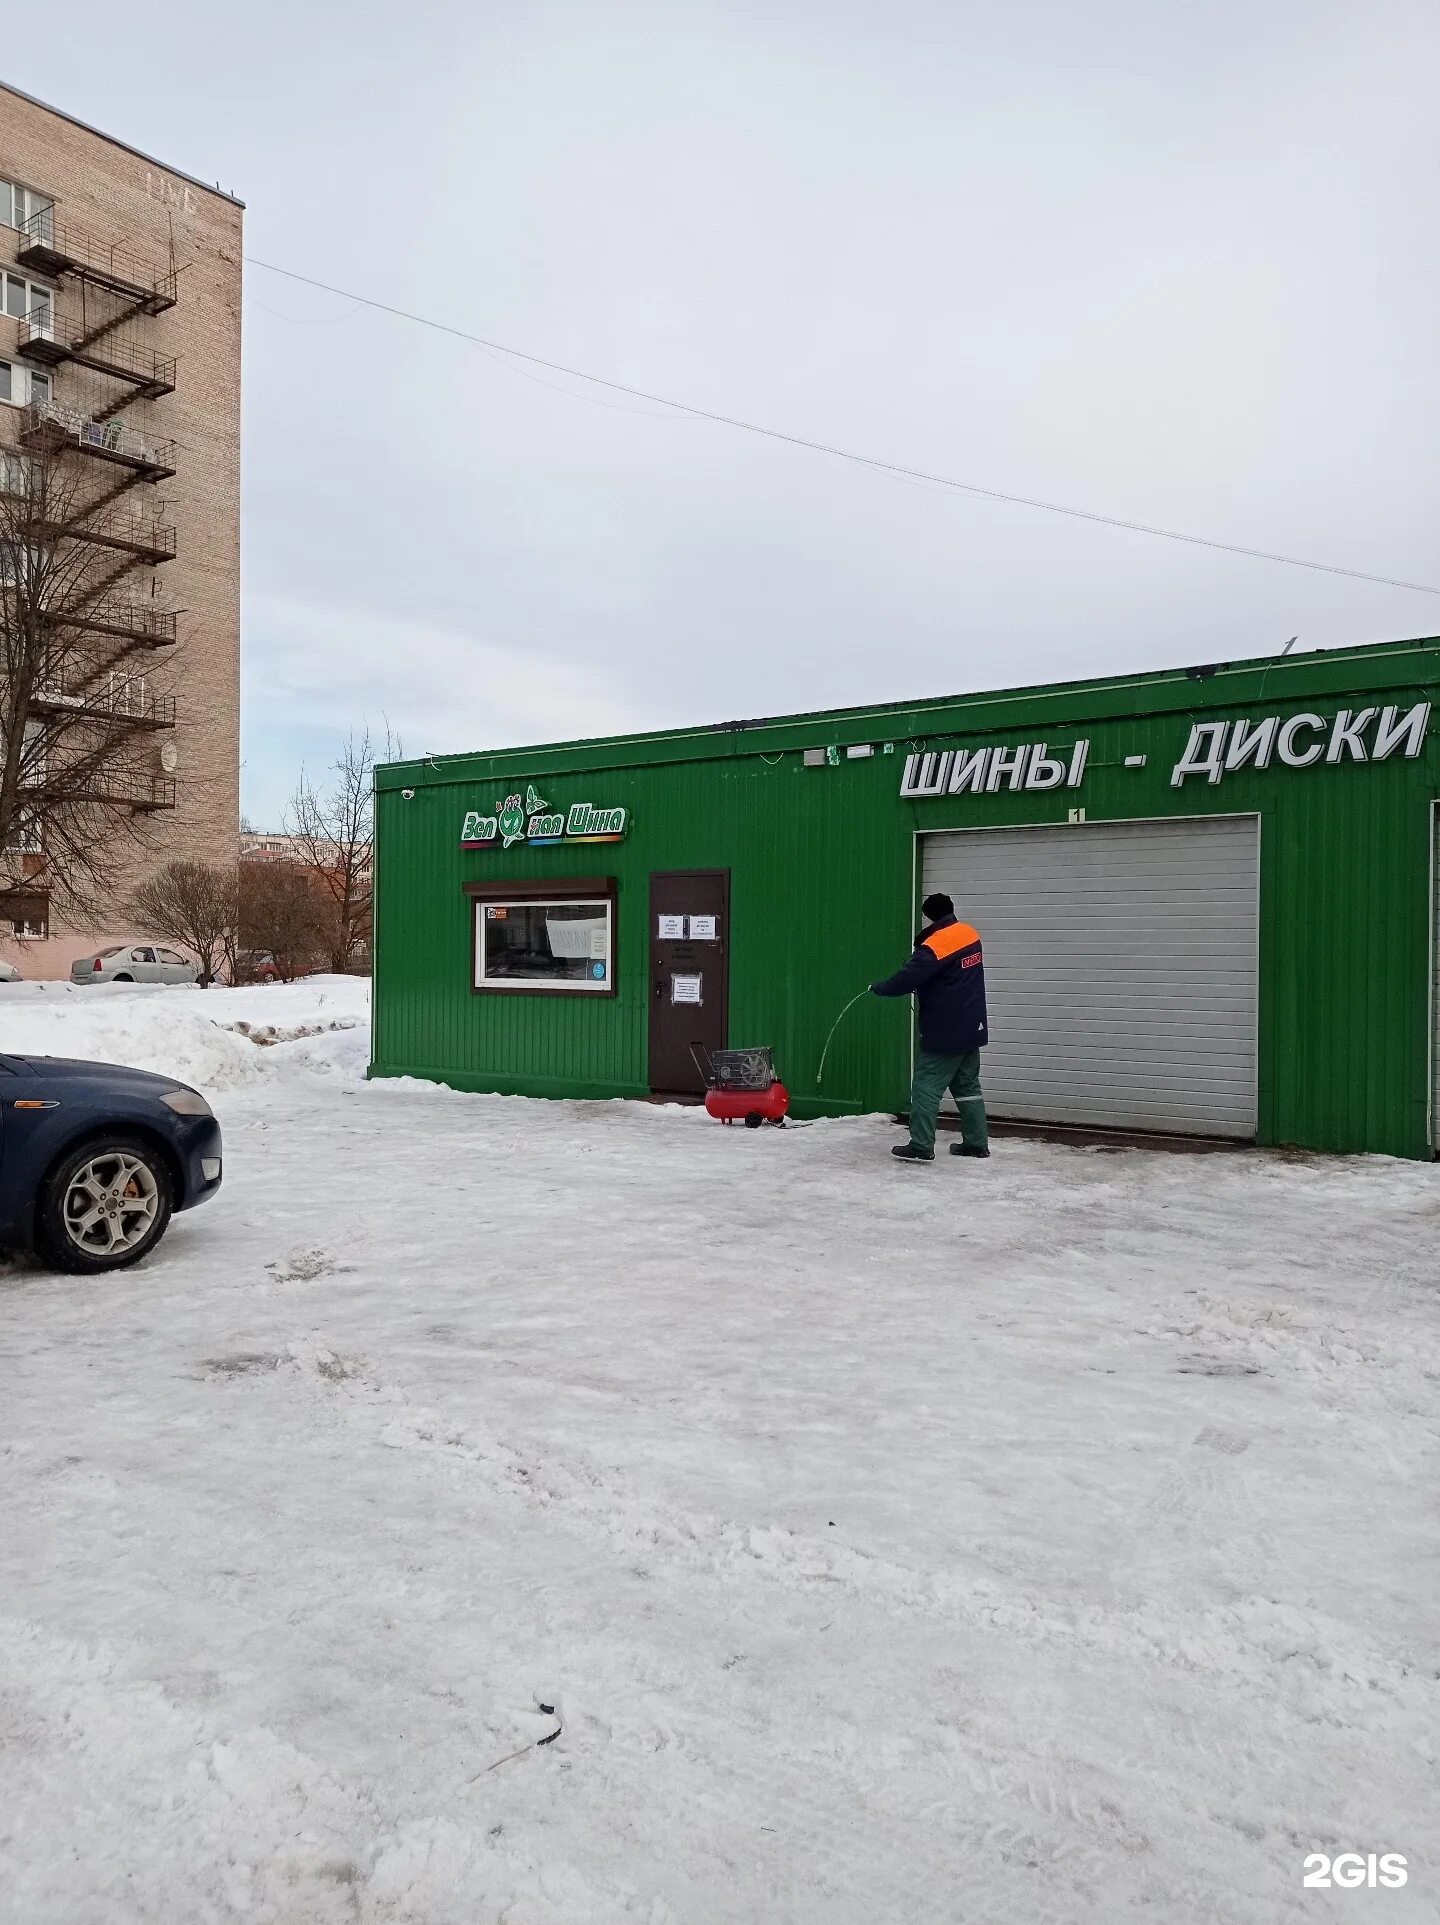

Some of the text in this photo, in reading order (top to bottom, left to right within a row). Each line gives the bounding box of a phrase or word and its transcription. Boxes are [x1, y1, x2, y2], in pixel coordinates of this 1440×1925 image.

[900, 739, 1090, 798] ШИНЫ
[1170, 701, 1432, 787] ДИСКИ
[567, 804, 626, 834] Шина
[1073, 808, 1080, 823] 1
